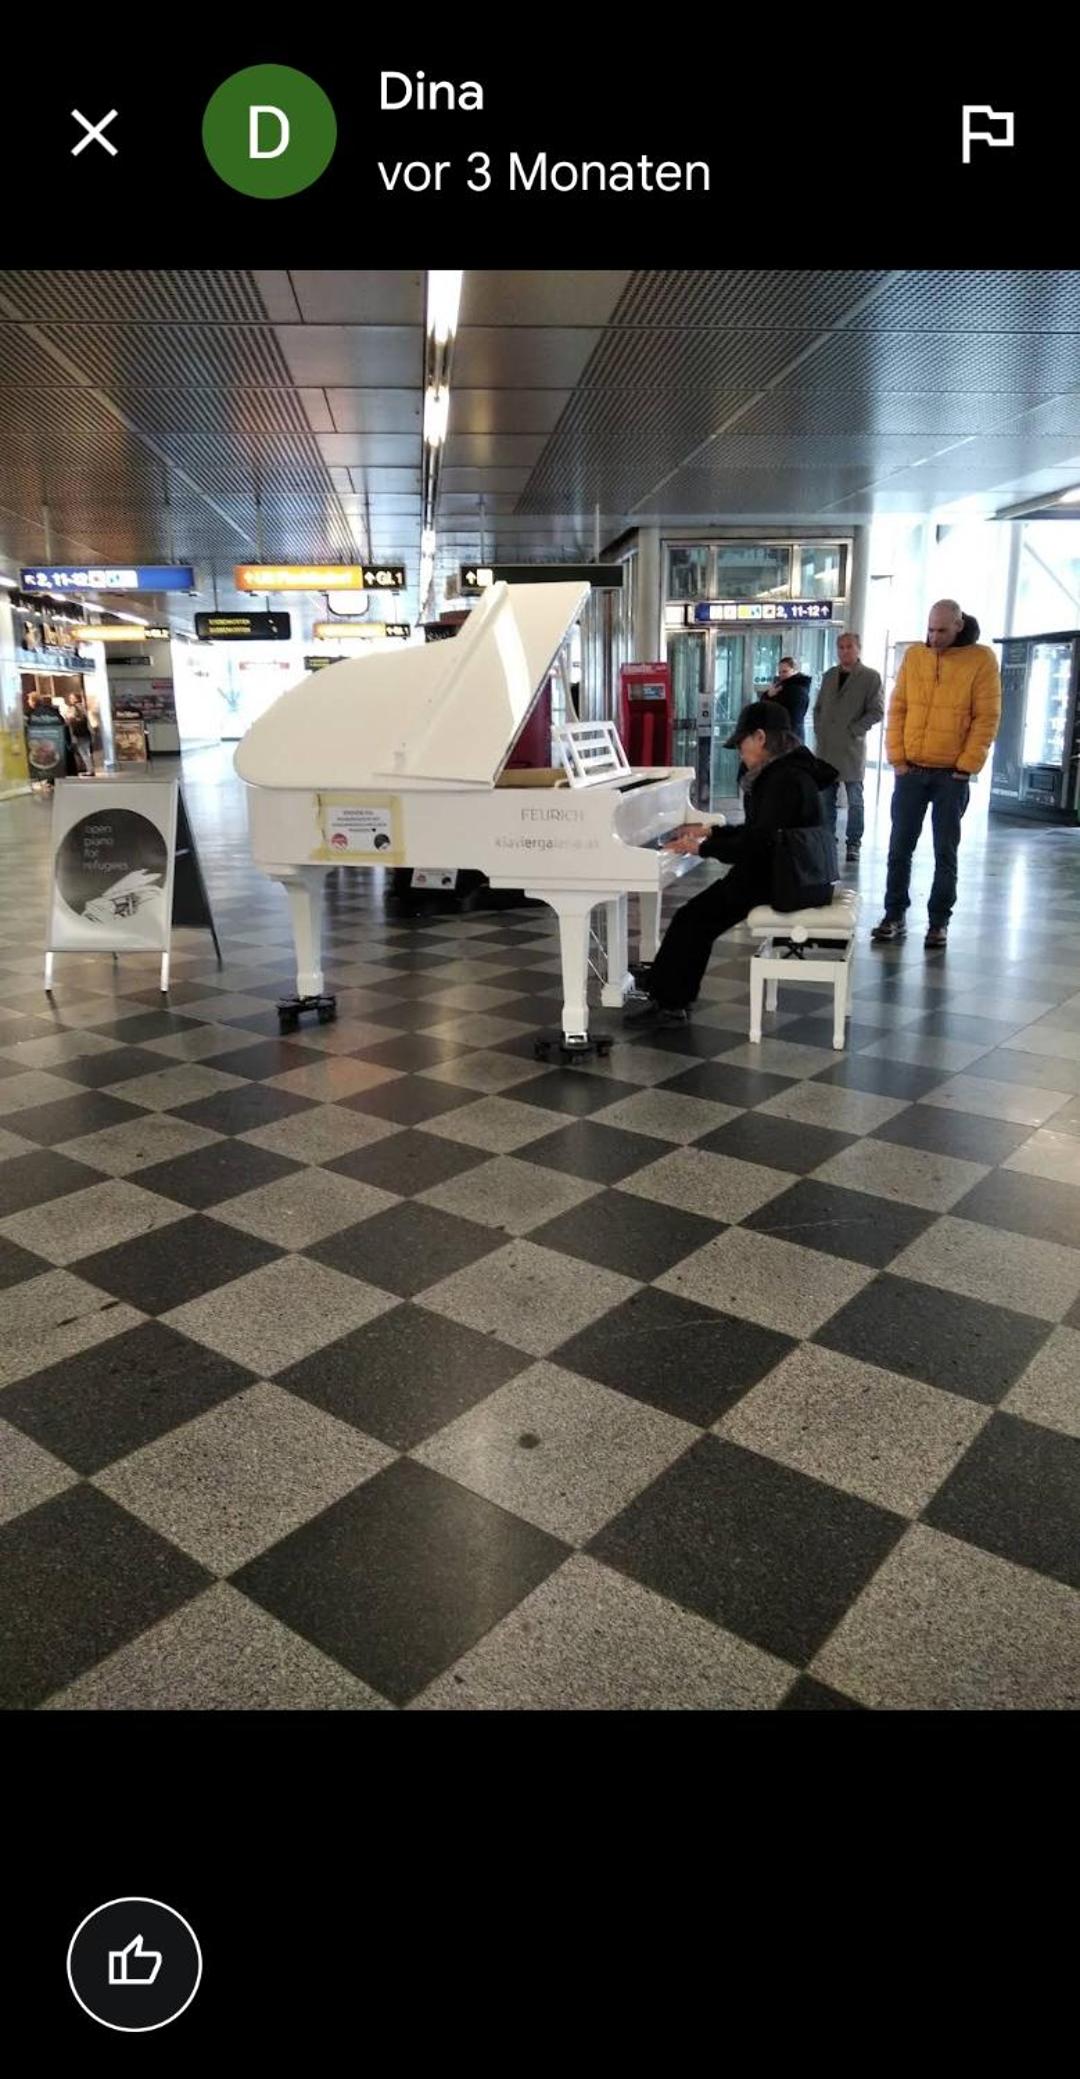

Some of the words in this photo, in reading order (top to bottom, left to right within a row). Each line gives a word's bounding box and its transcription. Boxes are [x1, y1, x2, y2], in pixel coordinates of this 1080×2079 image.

[791, 604, 820, 618] 11-12
[520, 808, 585, 822] FEURICH
[85, 825, 112, 836] open
[83, 837, 114, 848] piano
[84, 848, 99, 858] for
